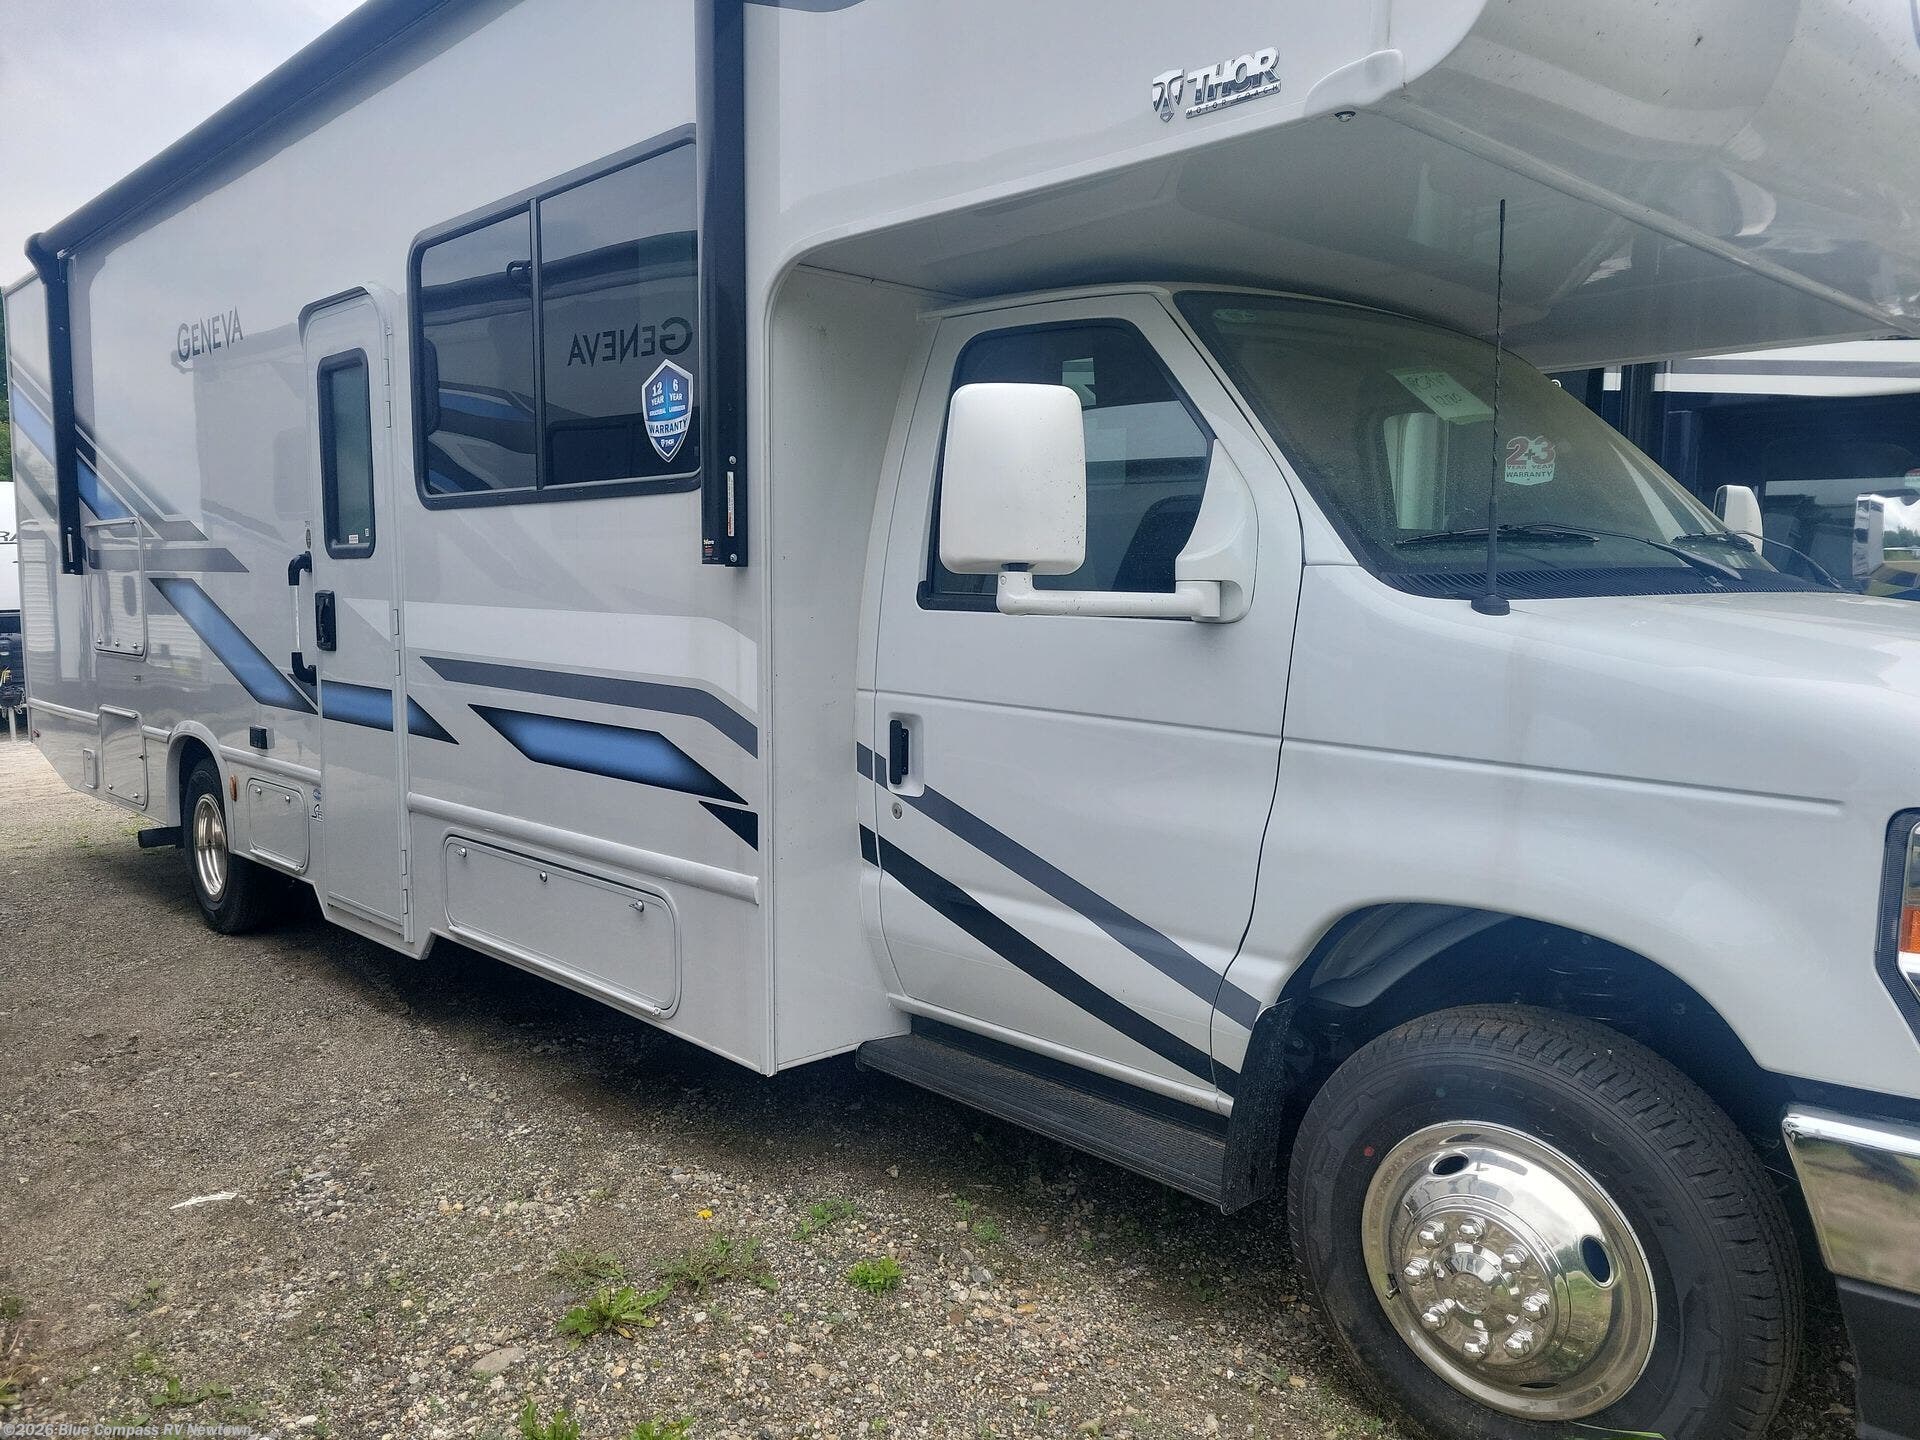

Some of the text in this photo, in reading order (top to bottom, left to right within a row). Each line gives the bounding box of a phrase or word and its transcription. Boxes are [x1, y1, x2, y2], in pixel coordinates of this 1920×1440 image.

[1187, 47, 1280, 105] THOR
[1187, 84, 1279, 116] MOTOR COACH
[177, 304, 243, 362] GENEVA
[652, 378, 679, 397] 12 6
[651, 392, 683, 406] YEAR YEAR
[648, 418, 688, 434] WARRANTY
[1506, 470, 1553, 478] WARRANTY
